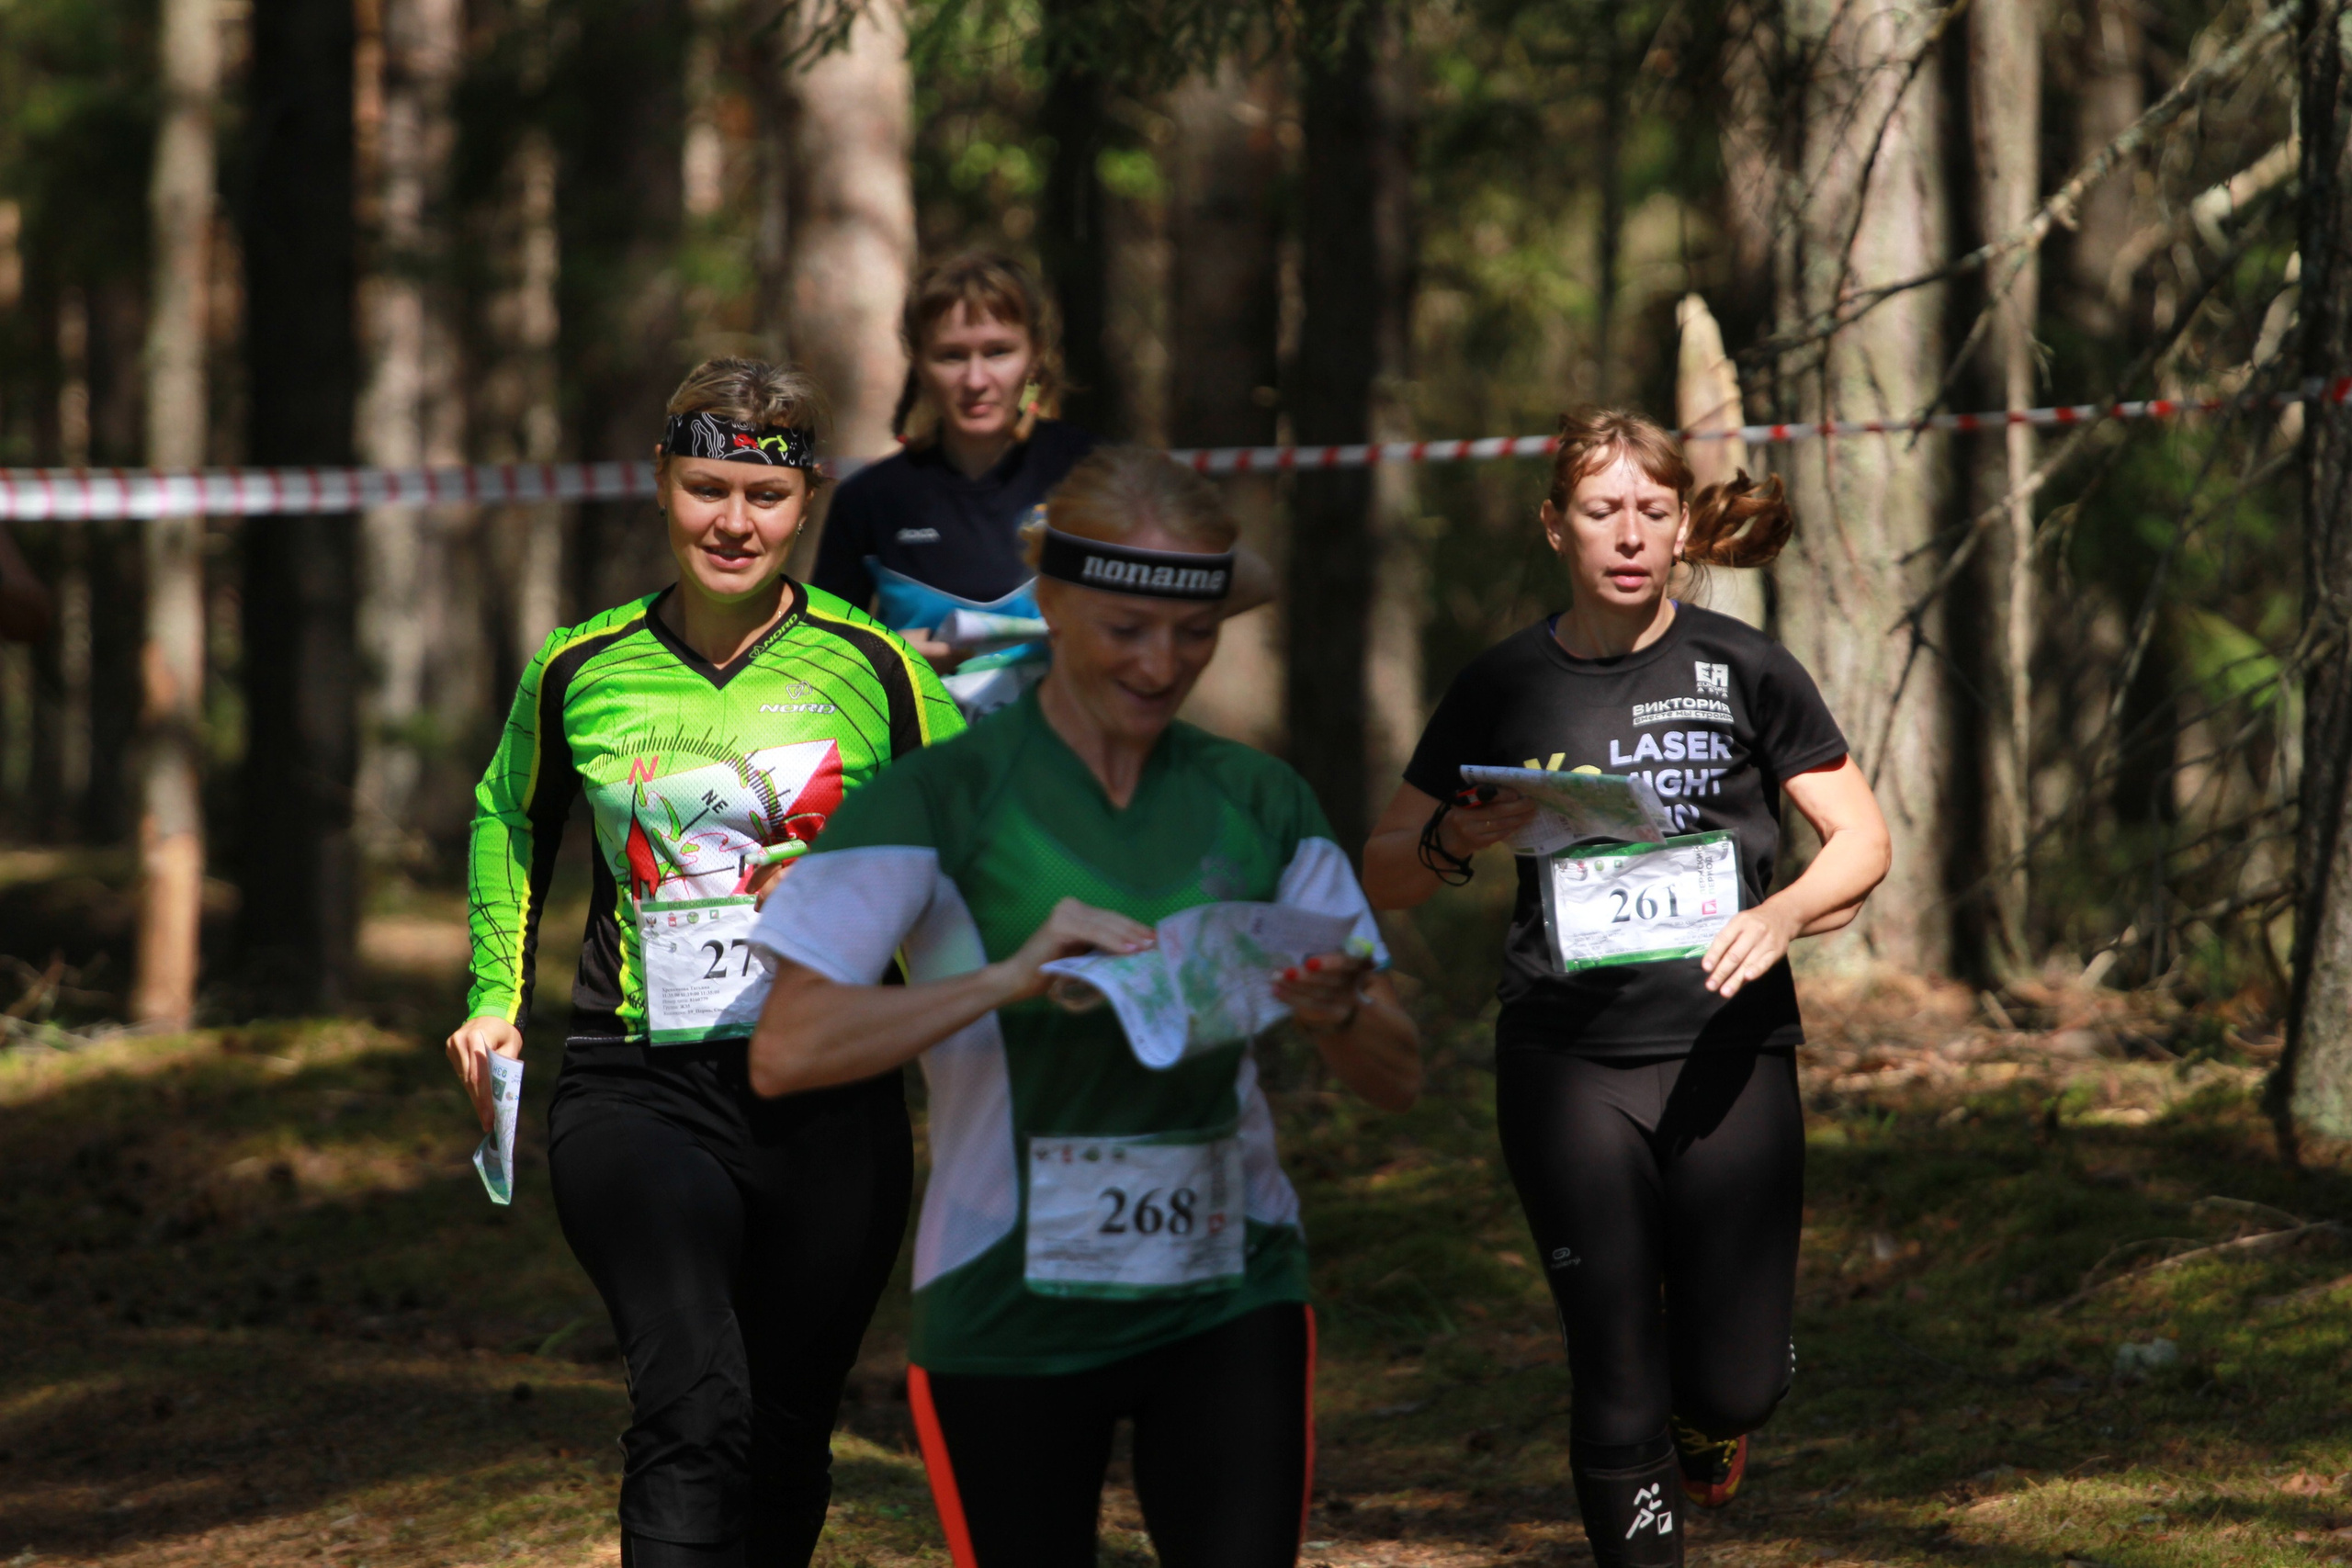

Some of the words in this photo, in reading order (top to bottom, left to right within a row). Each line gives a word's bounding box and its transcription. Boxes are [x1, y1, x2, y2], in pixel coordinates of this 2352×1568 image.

[1083, 556, 1227, 590] noname
[763, 613, 798, 649] NORD
[759, 703, 837, 715] NORD
[1632, 696, 1732, 717] ВИКТОРИЯ
[1634, 710, 1673, 724] вместе
[1694, 711, 1734, 721] строим
[1610, 730, 1734, 768] LASER
[1629, 768, 1728, 798] IGHT
[700, 788, 729, 815] NE
[1609, 882, 1680, 924] 261
[700, 938, 754, 980] 27
[1098, 1186, 1197, 1235] 268
